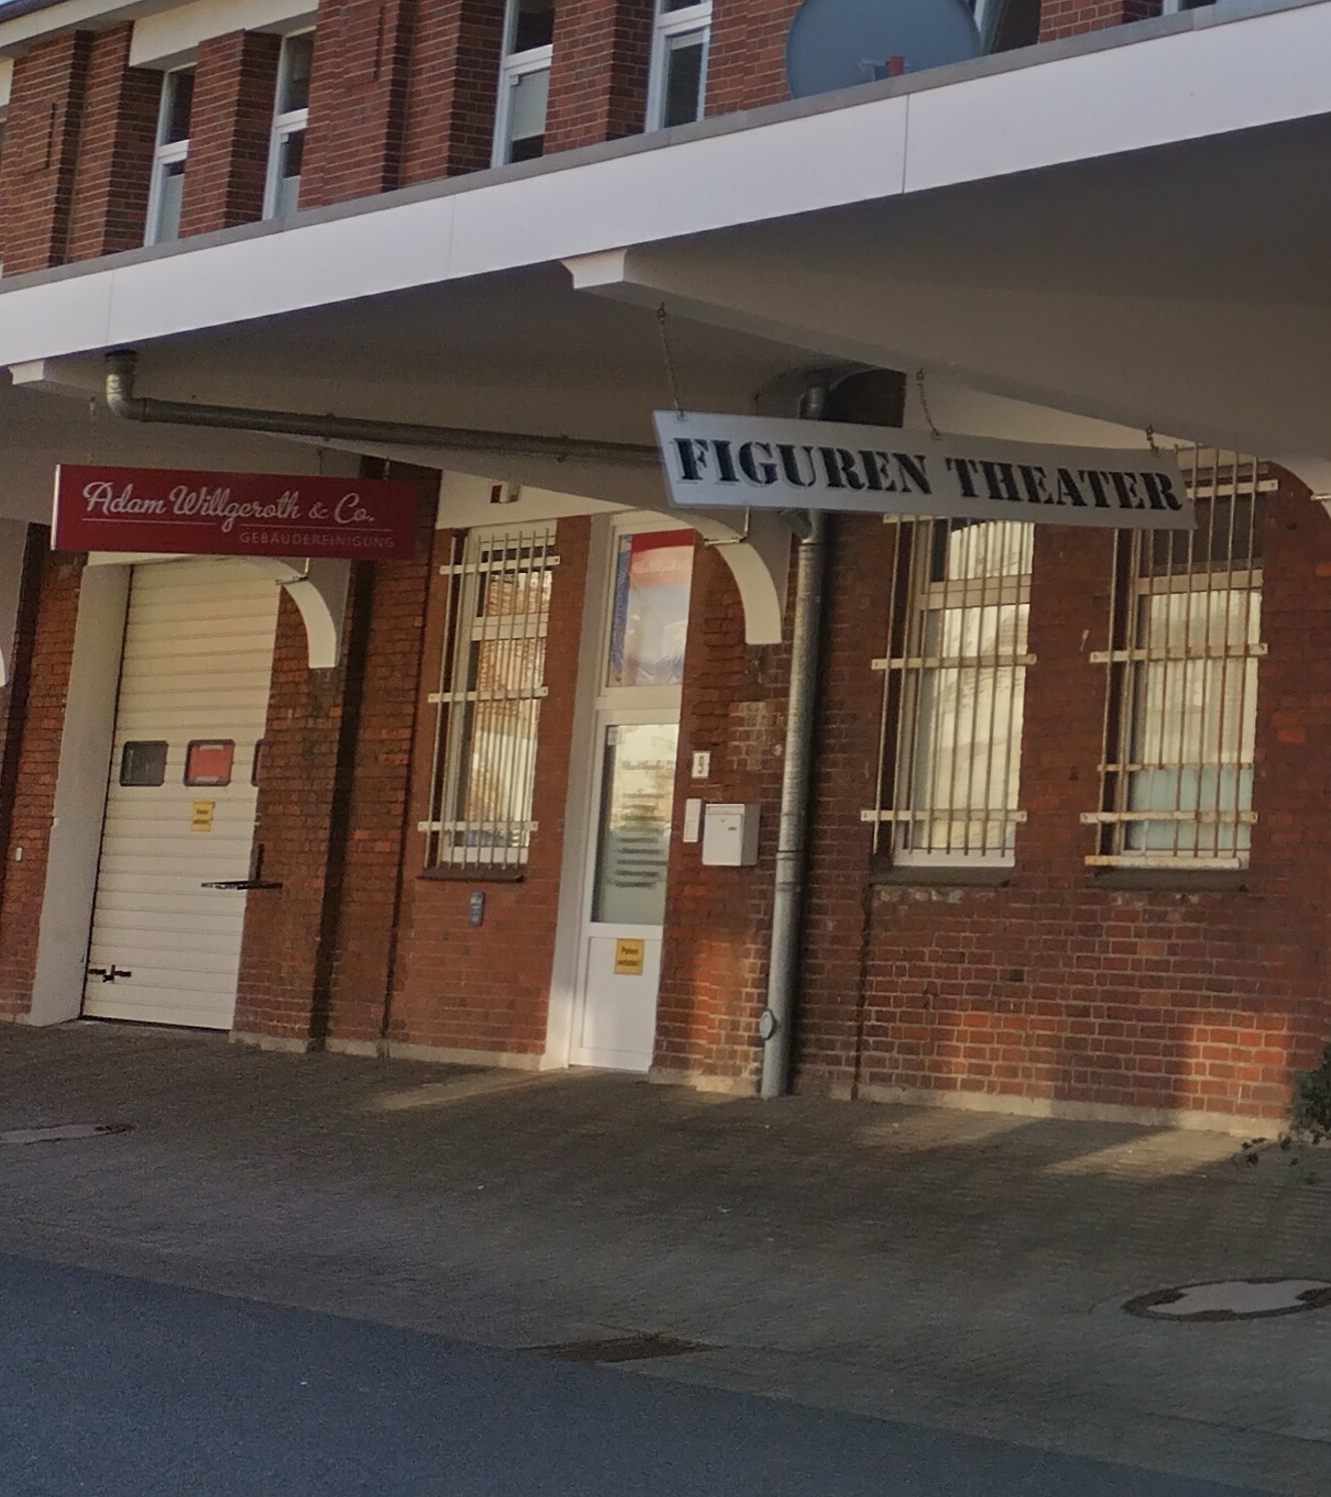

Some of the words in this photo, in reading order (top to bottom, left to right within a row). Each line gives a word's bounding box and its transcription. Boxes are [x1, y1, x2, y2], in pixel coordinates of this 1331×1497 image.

[672, 436, 932, 495] FIGUREN
[945, 456, 1184, 512] THEATER
[82, 481, 167, 516] Adam
[168, 484, 302, 533] Willgeroth
[308, 501, 329, 520] &
[334, 492, 376, 524] Co.
[239, 530, 396, 549] GEBÄUDEREINIGUNG
